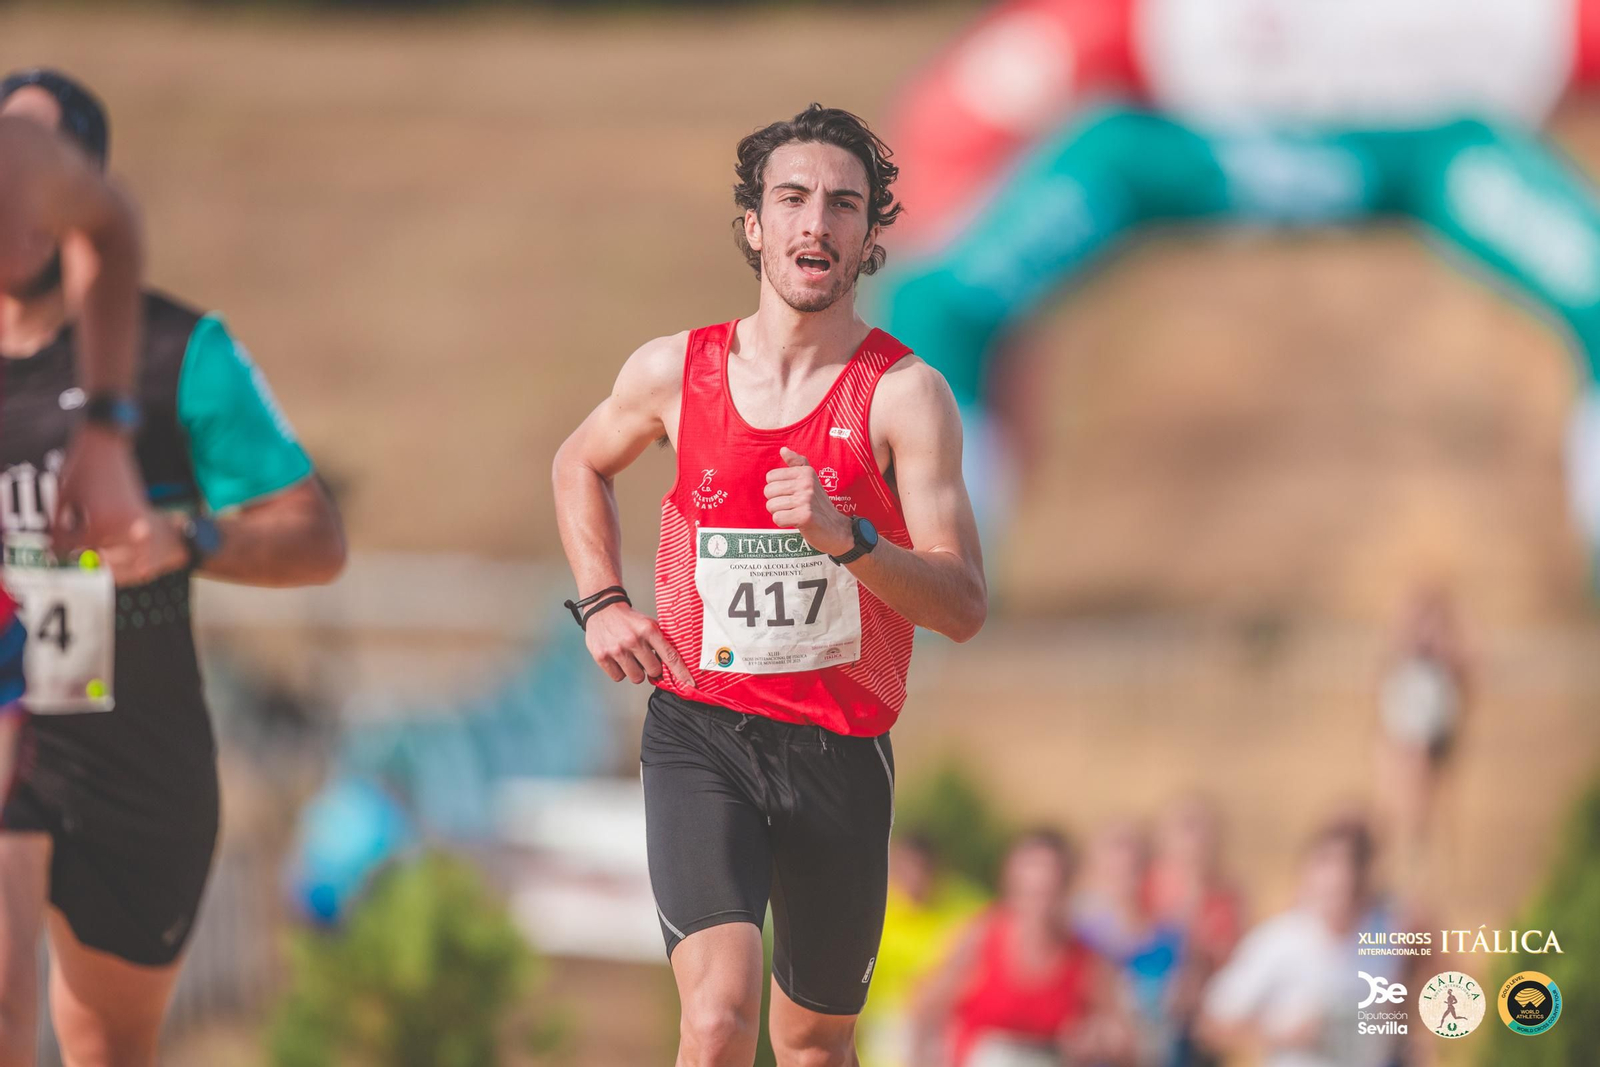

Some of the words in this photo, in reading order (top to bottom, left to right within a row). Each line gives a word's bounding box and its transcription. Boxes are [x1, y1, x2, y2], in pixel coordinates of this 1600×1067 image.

[834, 502, 857, 512] CÓN
[738, 536, 812, 554] ITÁLICA
[796, 561, 822, 569] CRESPO
[728, 578, 828, 627] 417
[22, 602, 72, 654] 4
